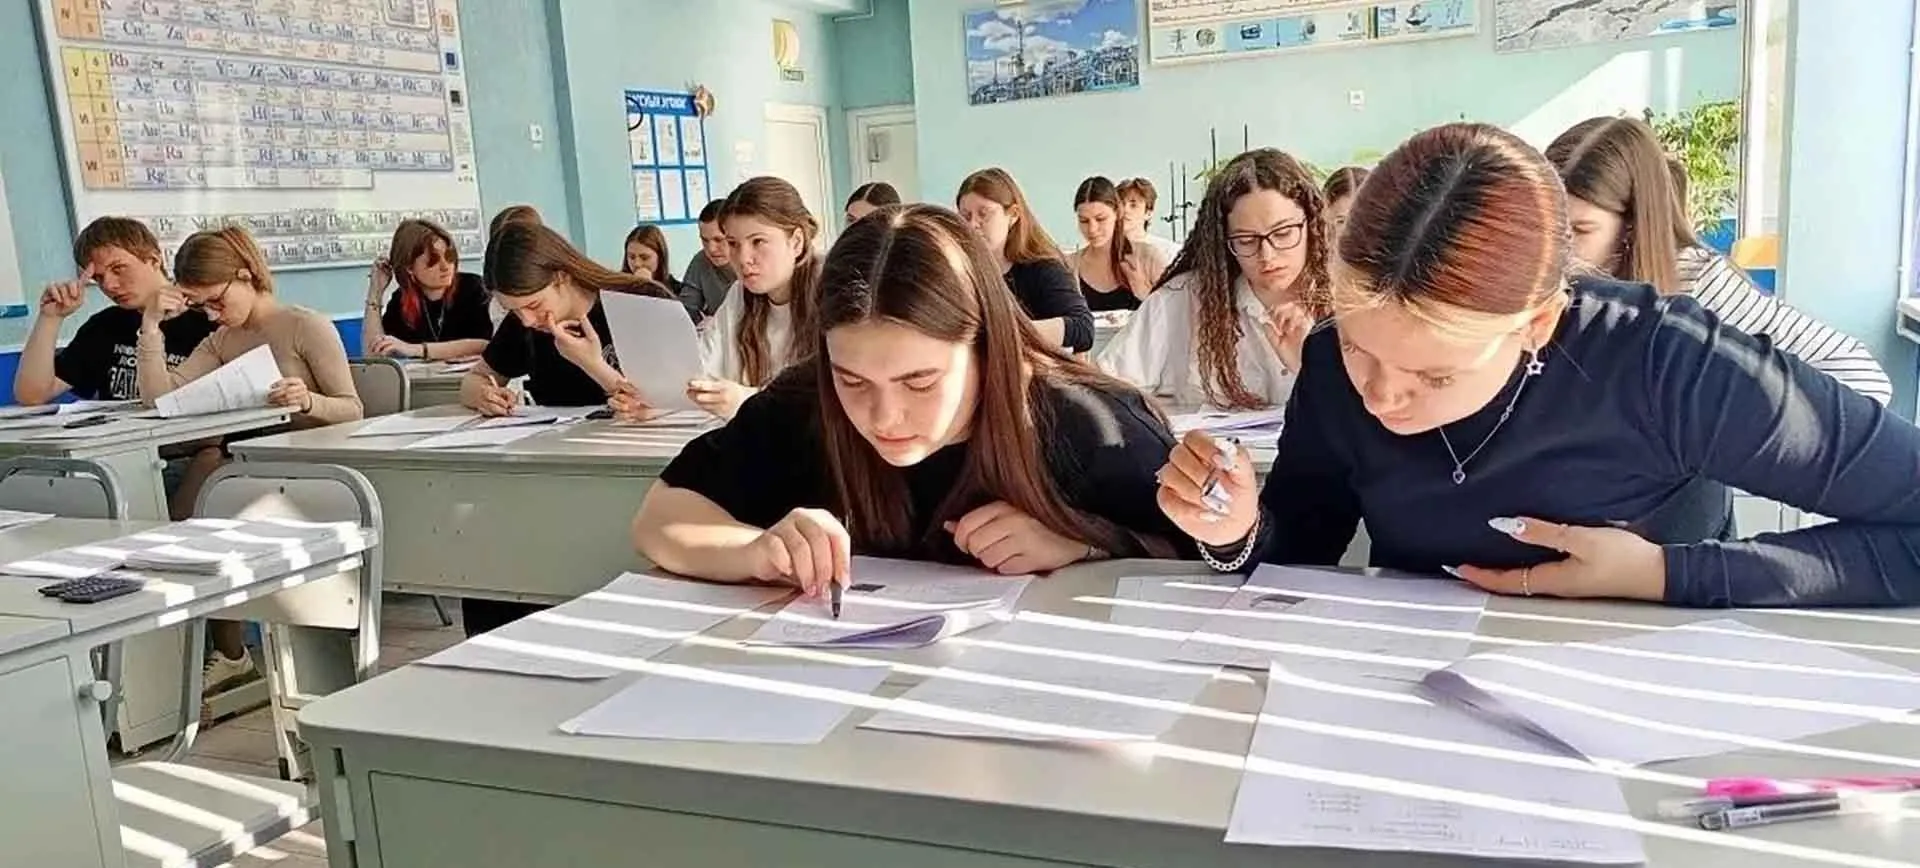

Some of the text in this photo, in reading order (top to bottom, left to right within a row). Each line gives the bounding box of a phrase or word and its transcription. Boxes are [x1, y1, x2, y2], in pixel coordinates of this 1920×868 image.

[109, 52, 129, 67] Rb
[134, 77, 151, 94] Ag
[172, 79, 191, 95] Cd
[166, 146, 184, 160] Ra
[146, 167, 166, 183] Rg
